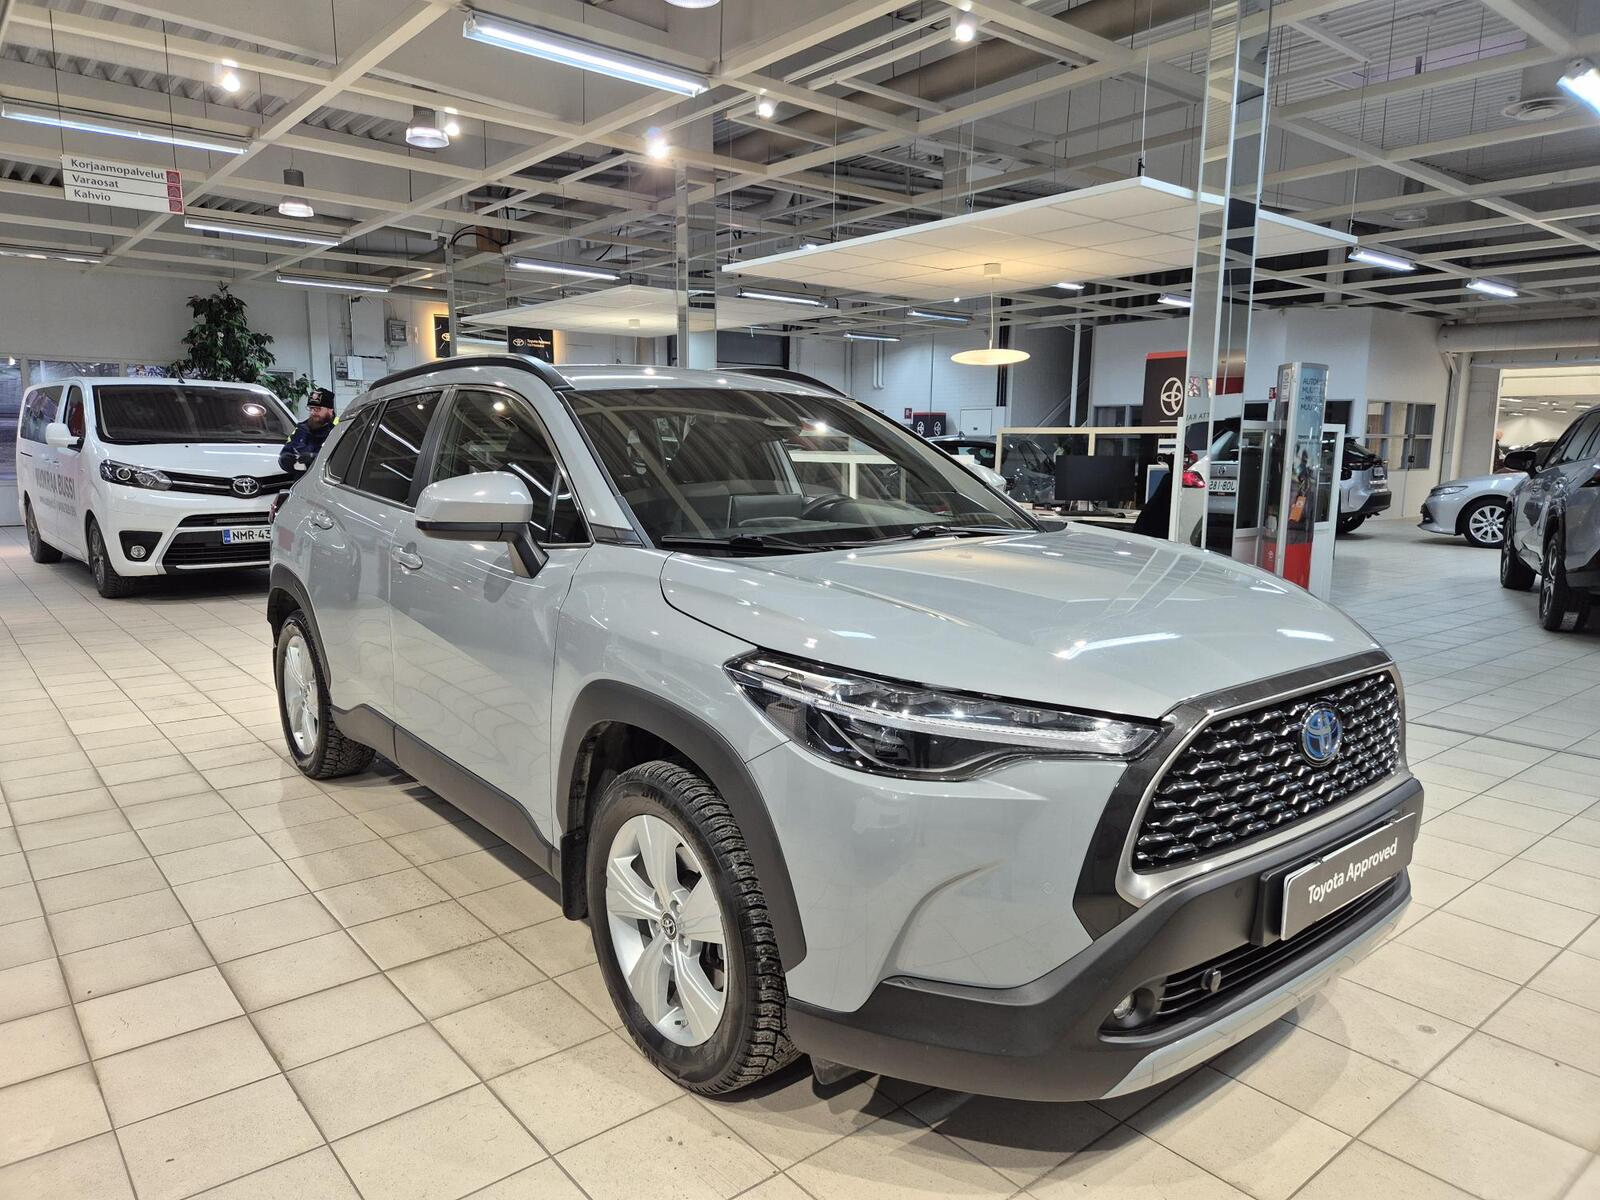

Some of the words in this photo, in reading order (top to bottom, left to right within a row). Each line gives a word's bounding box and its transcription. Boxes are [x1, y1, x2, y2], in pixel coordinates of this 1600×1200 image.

[71, 158, 165, 180] Korjaamopalvelut
[72, 174, 119, 188] Varaosat
[74, 189, 111, 201] Kahvio
[57, 473, 76, 501] BUSSI
[232, 529, 271, 541] NMR-43
[1308, 871, 1344, 904] Toyota
[1345, 837, 1398, 882] Approved
